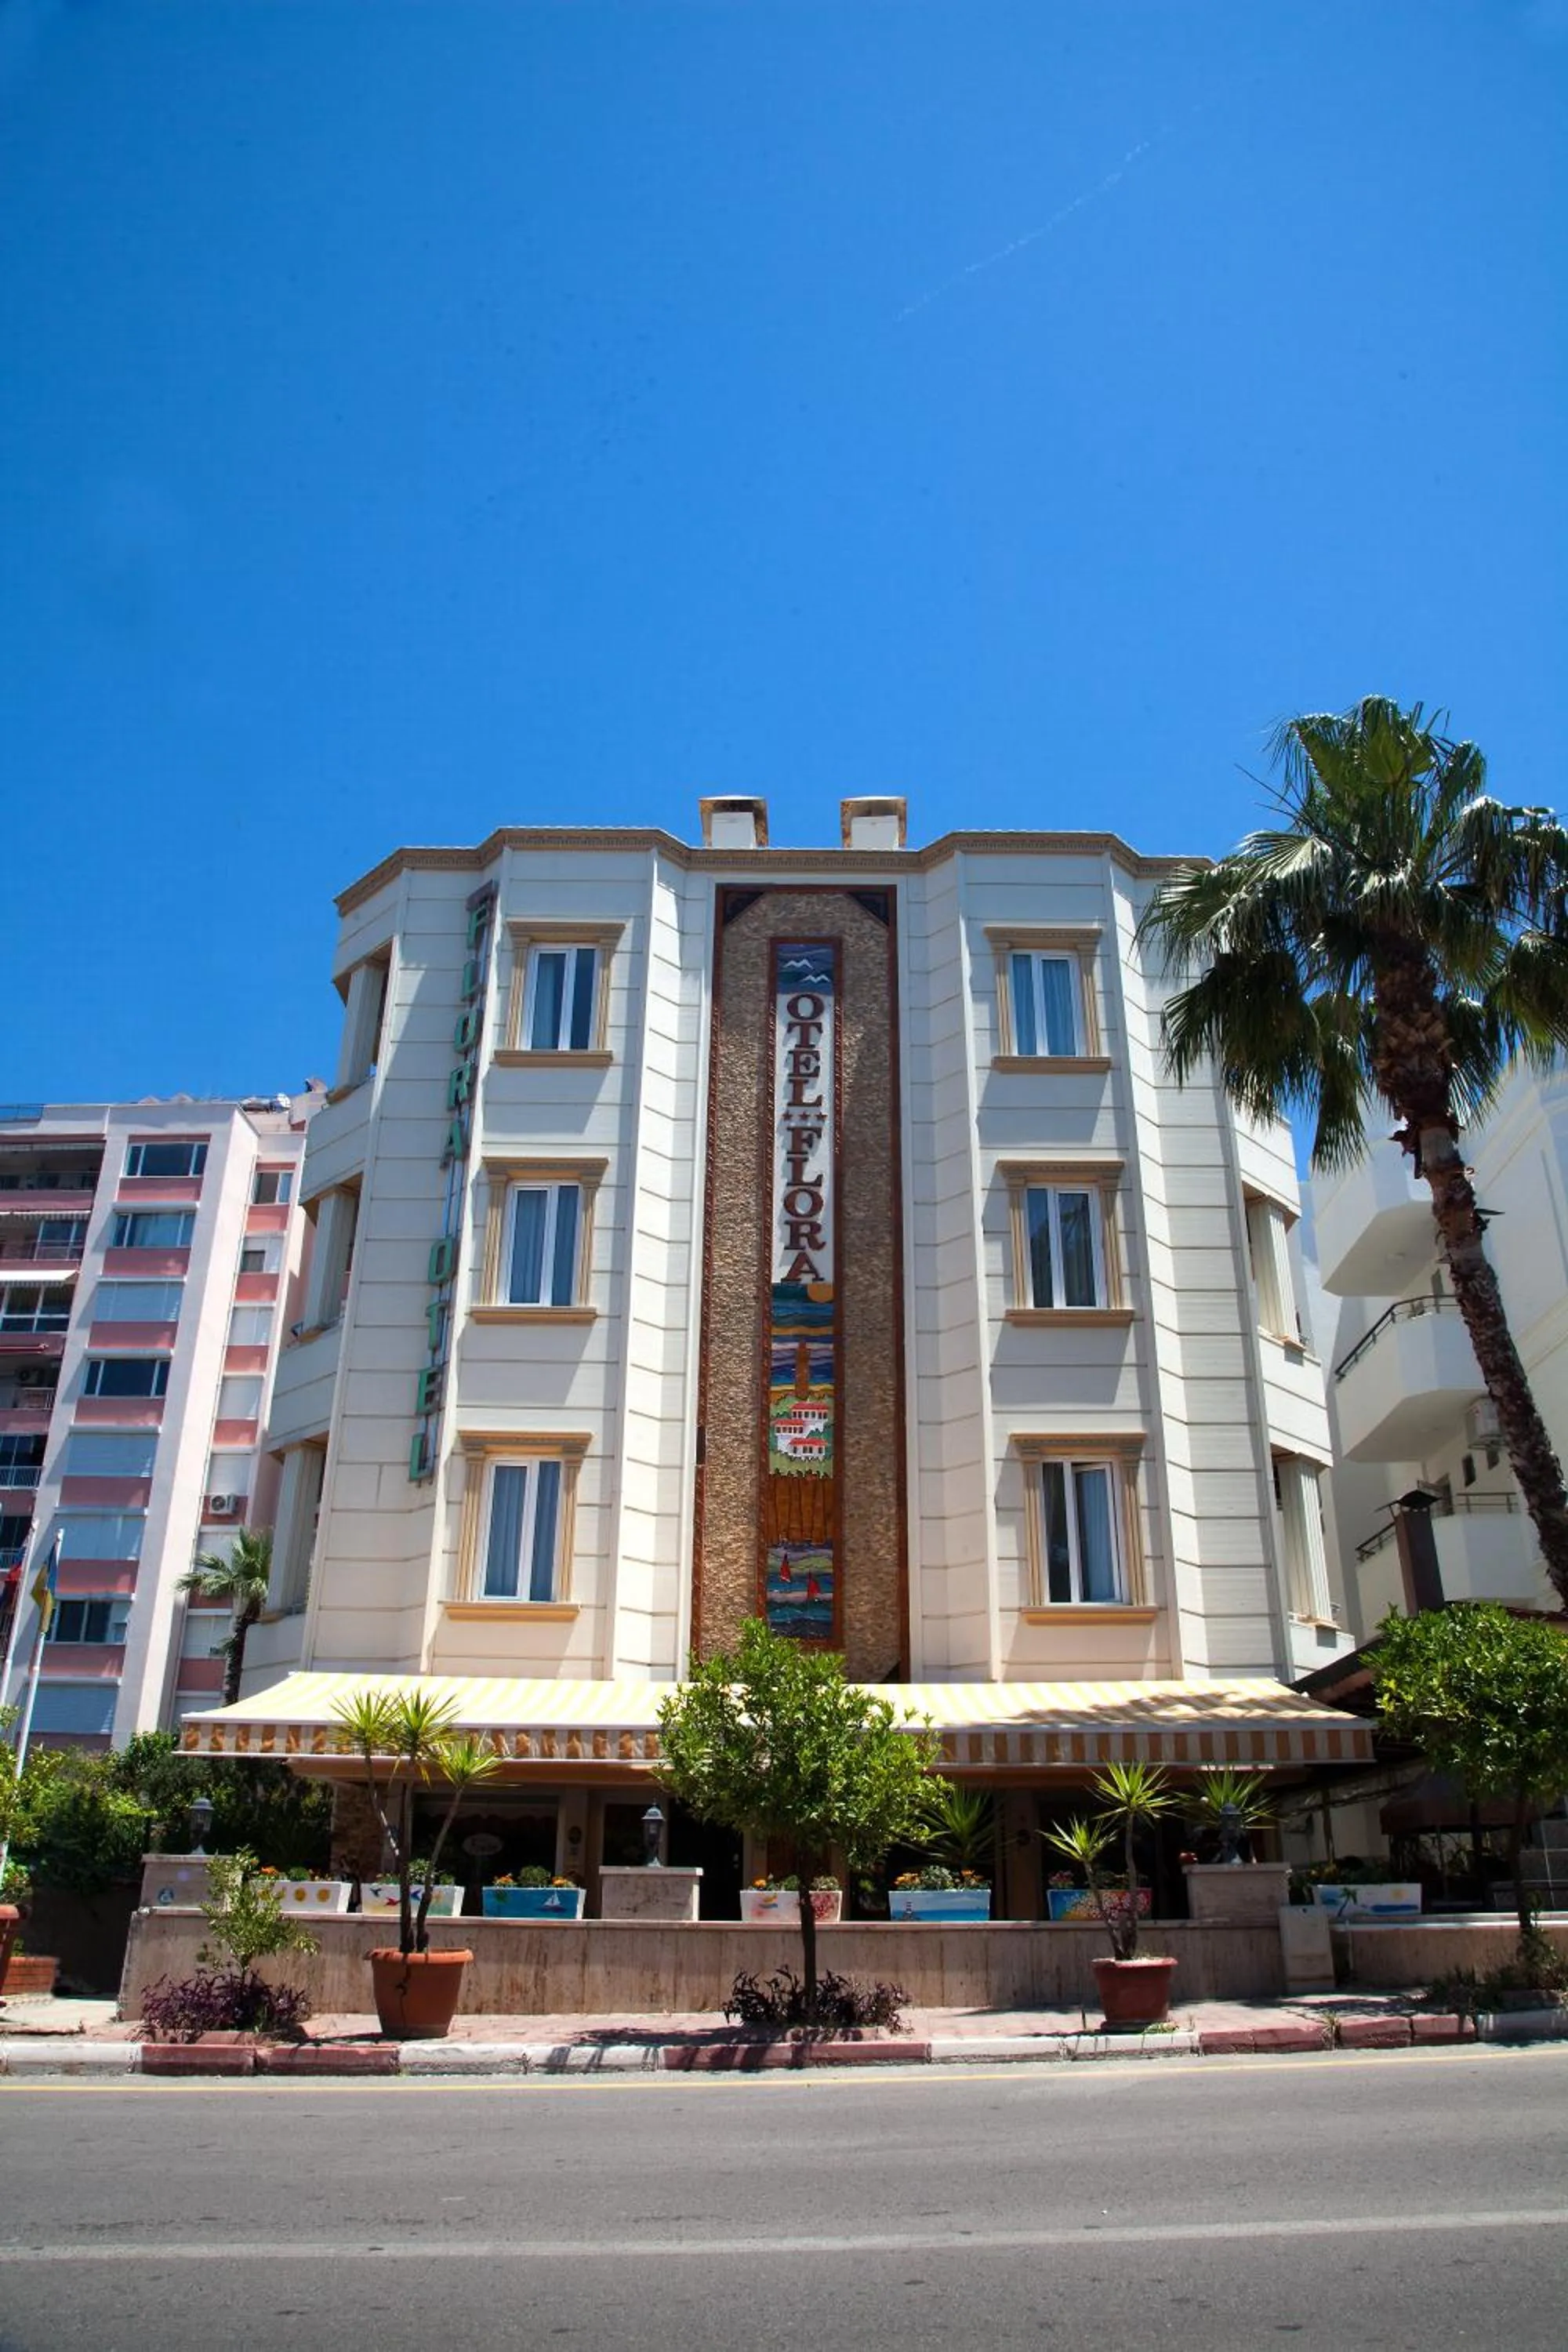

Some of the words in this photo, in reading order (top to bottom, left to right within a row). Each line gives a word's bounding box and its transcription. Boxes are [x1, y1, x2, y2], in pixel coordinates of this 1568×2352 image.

[440, 899, 489, 1168] FLORA
[786, 993, 826, 1107] OTEL
[781, 1127, 827, 1282] FLORA
[408, 1234, 455, 1482] OTEL
